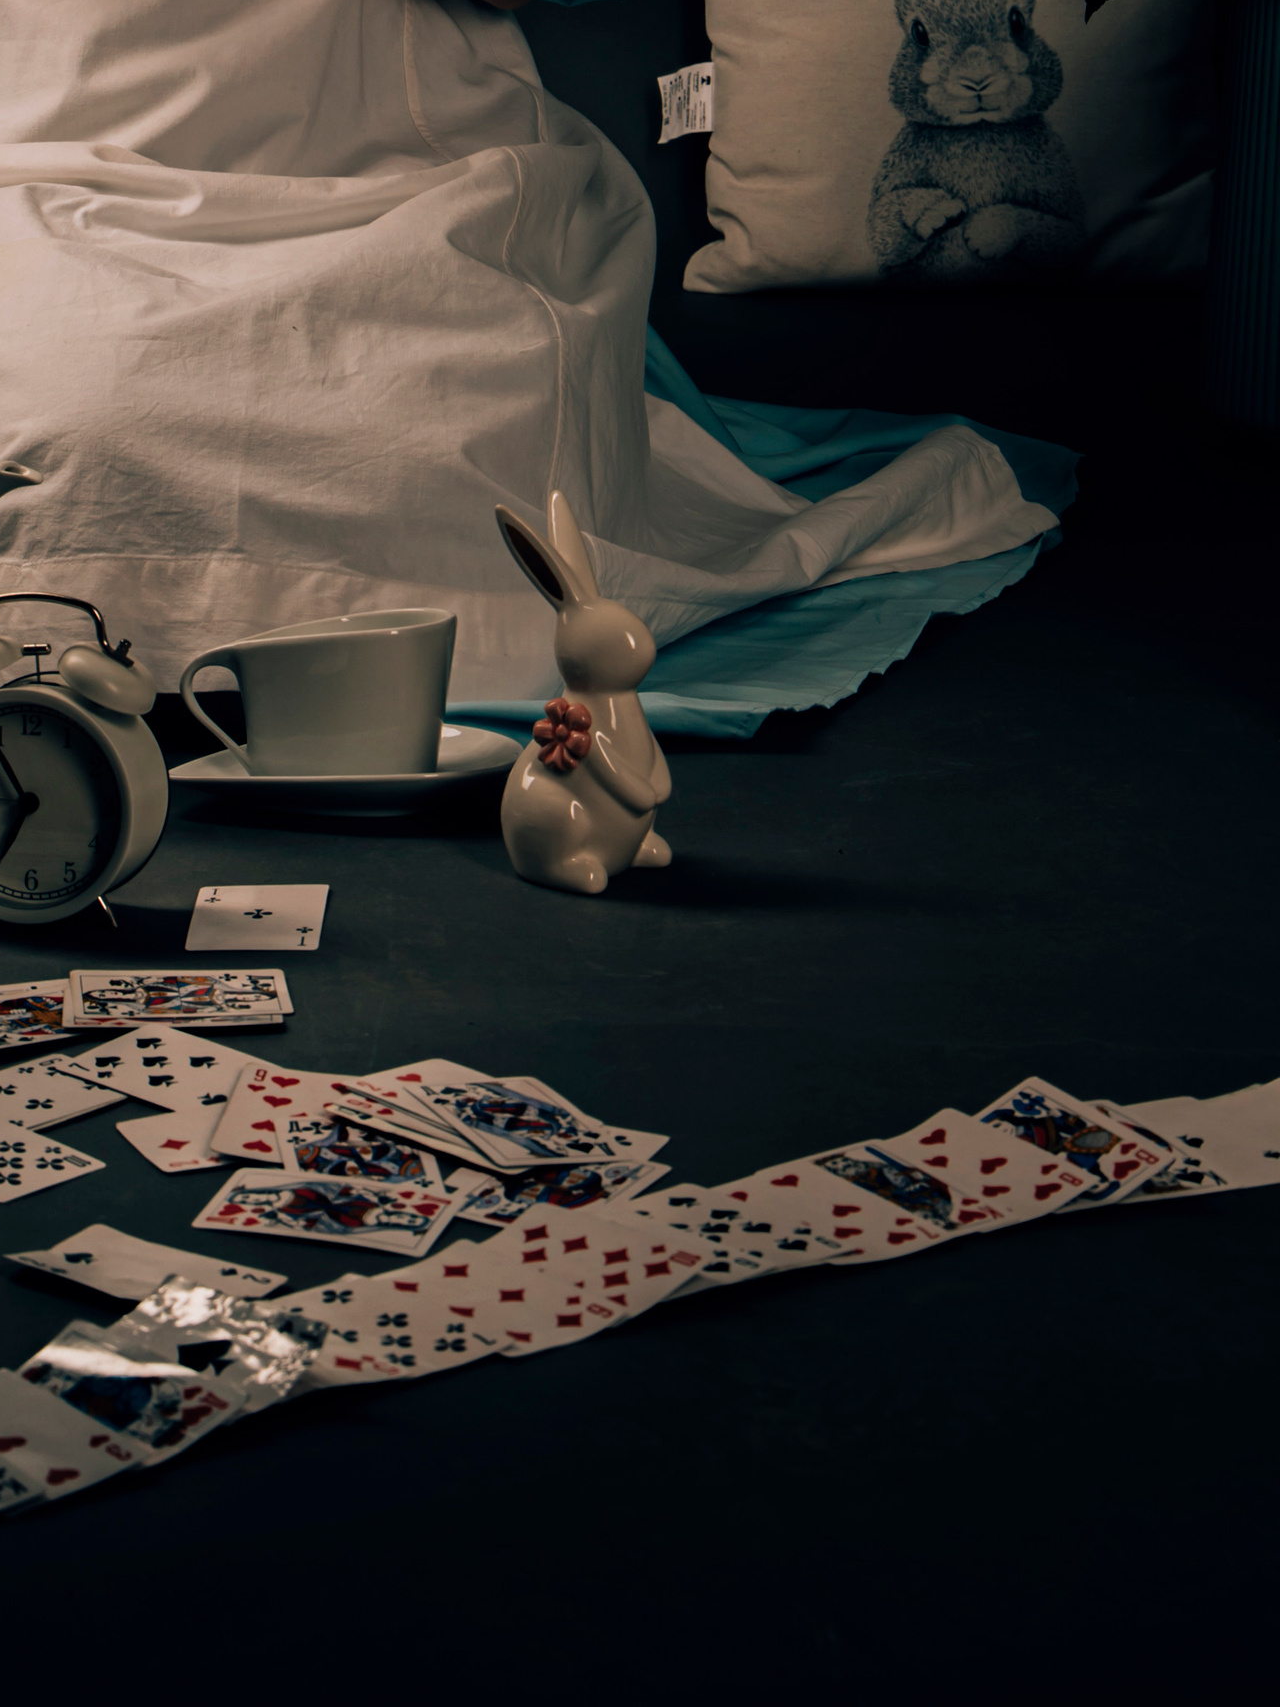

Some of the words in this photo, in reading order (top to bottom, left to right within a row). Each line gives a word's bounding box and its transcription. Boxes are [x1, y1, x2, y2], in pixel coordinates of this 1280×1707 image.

[21, 714, 42, 736] 12
[63, 727, 71, 749] 1
[24, 869, 38, 891] 6
[63, 861, 76, 883] 5
[254, 1069, 268, 1082] 9
